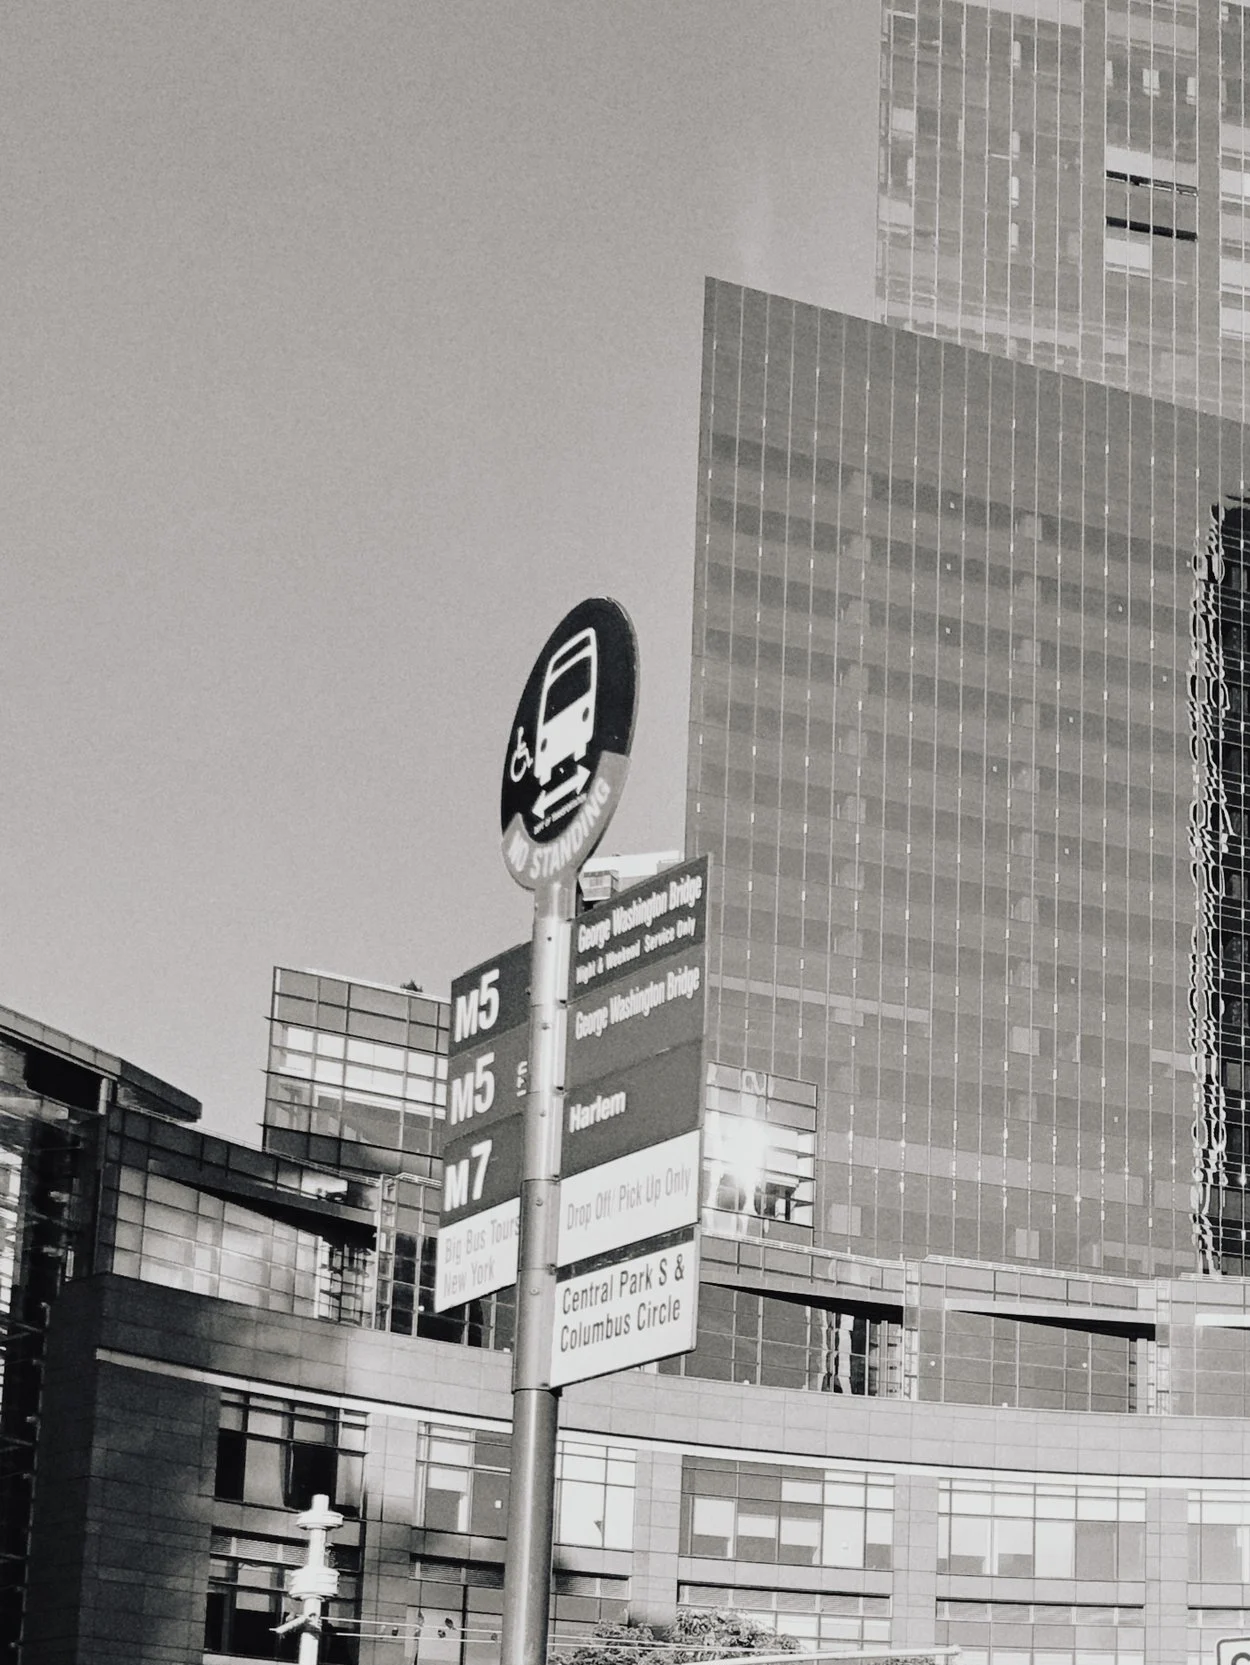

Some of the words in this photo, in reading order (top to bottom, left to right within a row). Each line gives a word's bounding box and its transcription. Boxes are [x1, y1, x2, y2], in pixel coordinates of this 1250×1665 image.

[508, 829, 529, 873] NO
[530, 777, 611, 880] STANDING
[578, 918, 611, 953] George
[612, 891, 668, 936] Washington
[669, 874, 703, 910] Bridge
[605, 939, 641, 970] Weekend
[644, 926, 675, 953] Service
[676, 916, 696, 938] Only
[454, 968, 500, 1043] M5
[575, 1006, 609, 1040] George
[610, 981, 666, 1025] Washington
[667, 965, 700, 1001] Bridge
[451, 1052, 495, 1126] M5
[569, 1091, 626, 1133] Harlem
[444, 1139, 493, 1212] M7
[567, 1202, 592, 1231] Drop
[618, 1180, 642, 1213] Pick
[645, 1174, 662, 1207] Up
[665, 1163, 691, 1197] Only
[445, 1237, 462, 1265] Big
[466, 1228, 486, 1255] Bus
[490, 1215, 520, 1245] Tours
[444, 1270, 467, 1298] New
[470, 1257, 495, 1287] York
[562, 1274, 614, 1315] Central
[619, 1263, 653, 1298] Park
[659, 1258, 668, 1287] S
[674, 1253, 685, 1282] &
[560, 1313, 631, 1353] Columbus
[637, 1295, 681, 1331] Circle
